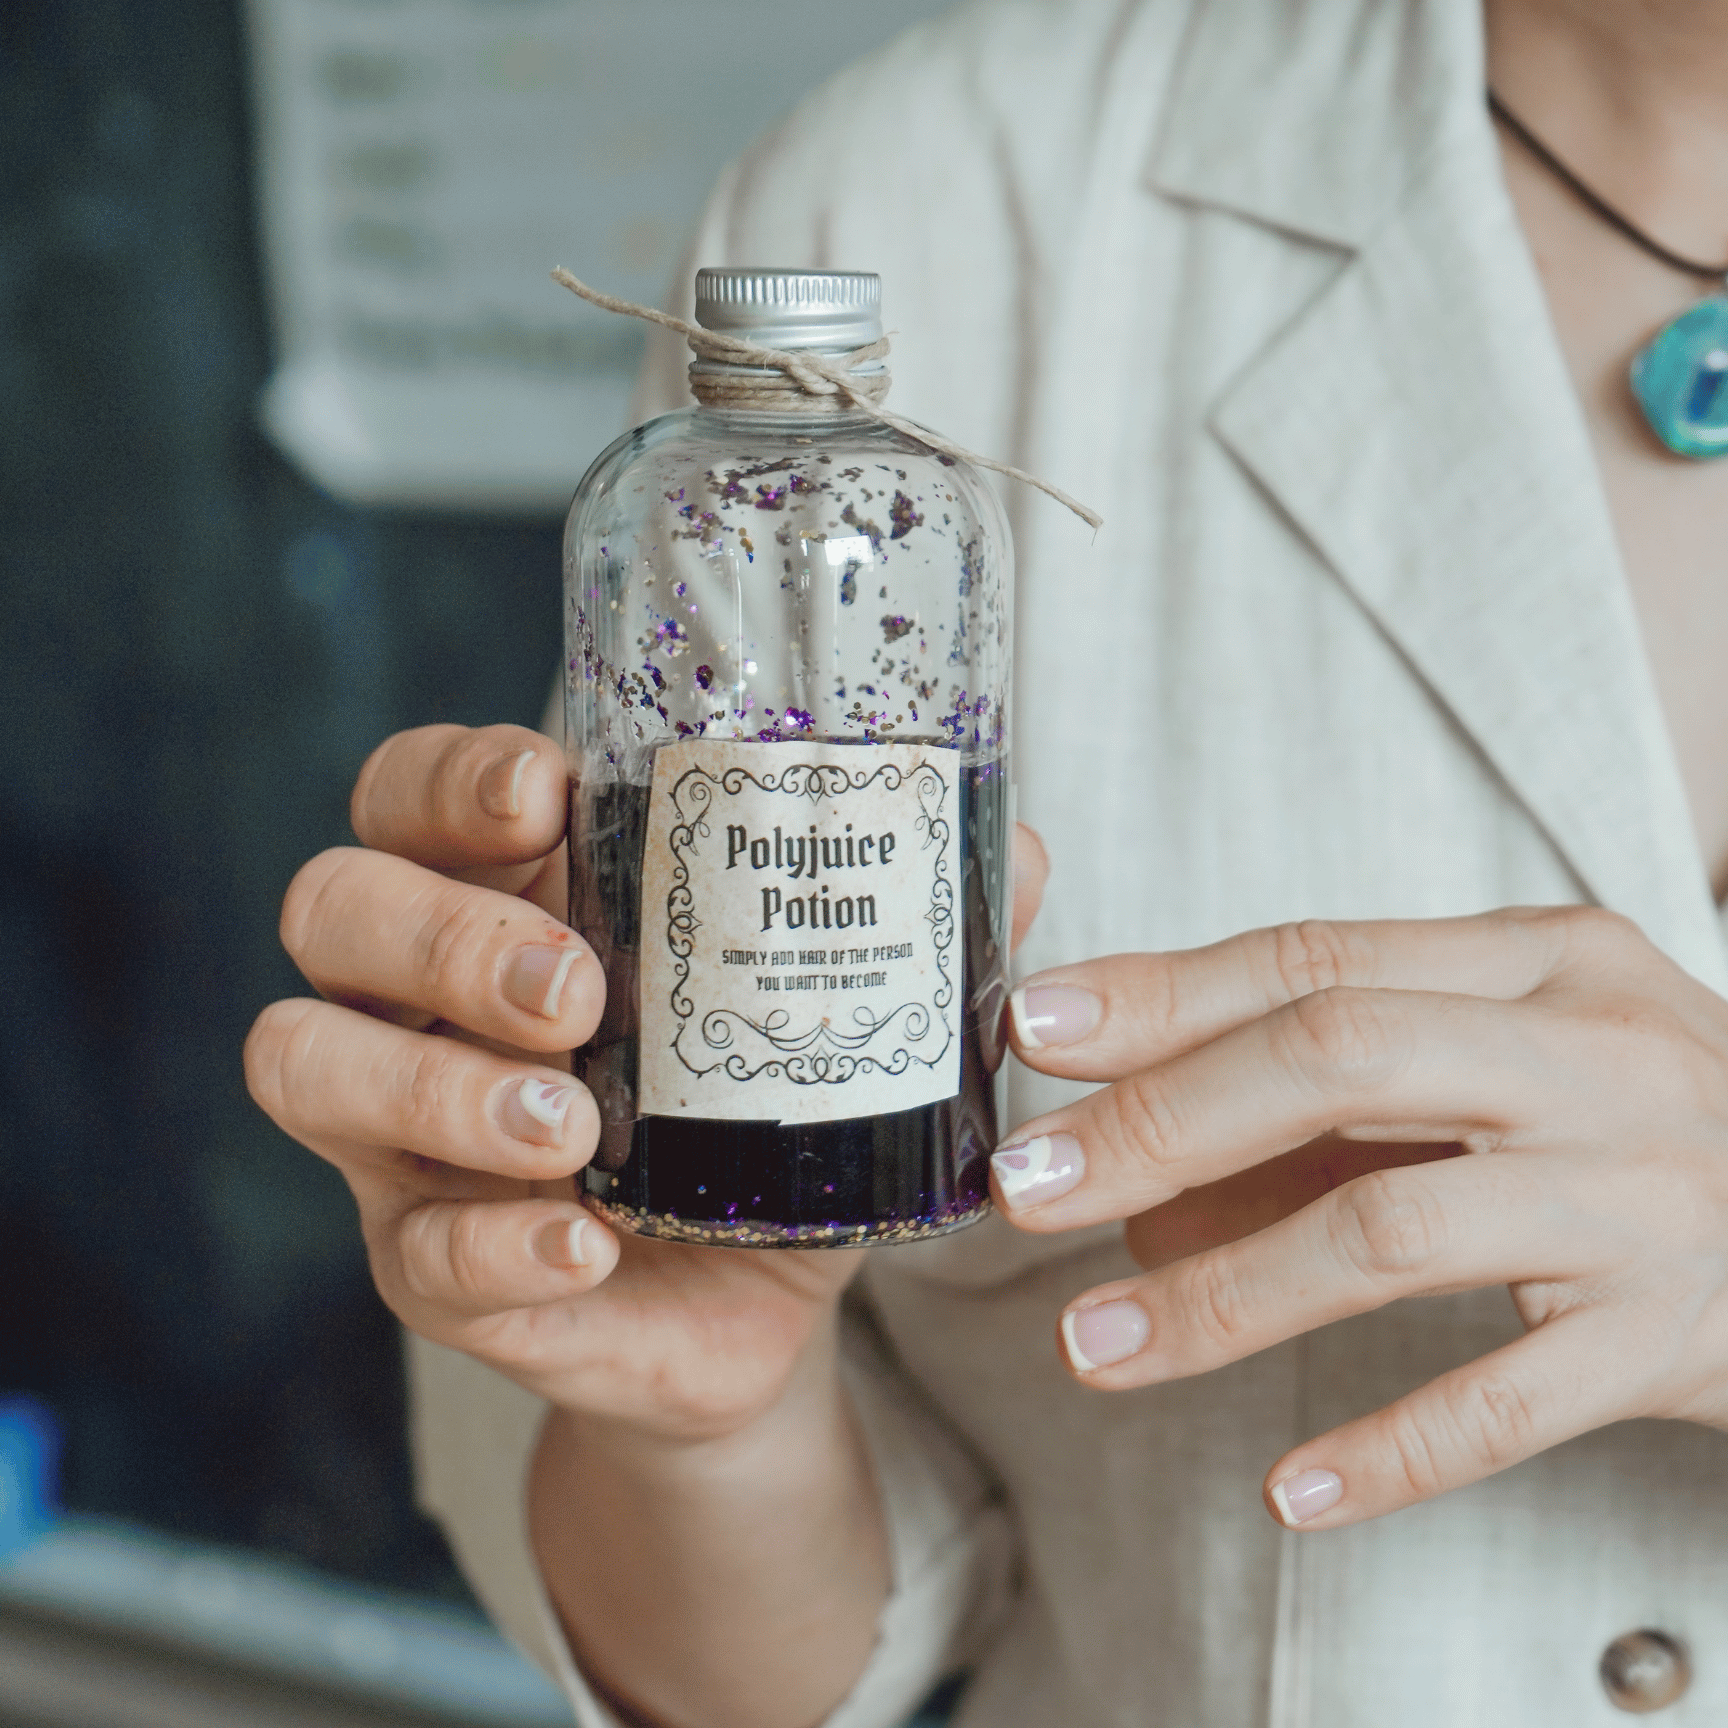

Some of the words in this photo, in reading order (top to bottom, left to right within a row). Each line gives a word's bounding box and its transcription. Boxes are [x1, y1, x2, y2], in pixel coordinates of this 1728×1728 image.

[725, 823, 896, 879] Polyjuice
[760, 884, 878, 932] Potion
[722, 949, 767, 966] SIMPLY
[771, 950, 794, 966] ADD
[798, 949, 827, 965] HAIR
[831, 949, 845, 965] OF
[848, 947, 869, 965] THE
[872, 942, 913, 963] PERSON
[756, 975, 780, 991] YOU
[784, 974, 820, 991] WANT
[821, 974, 837, 991] TO
[841, 970, 888, 990] BECOME
